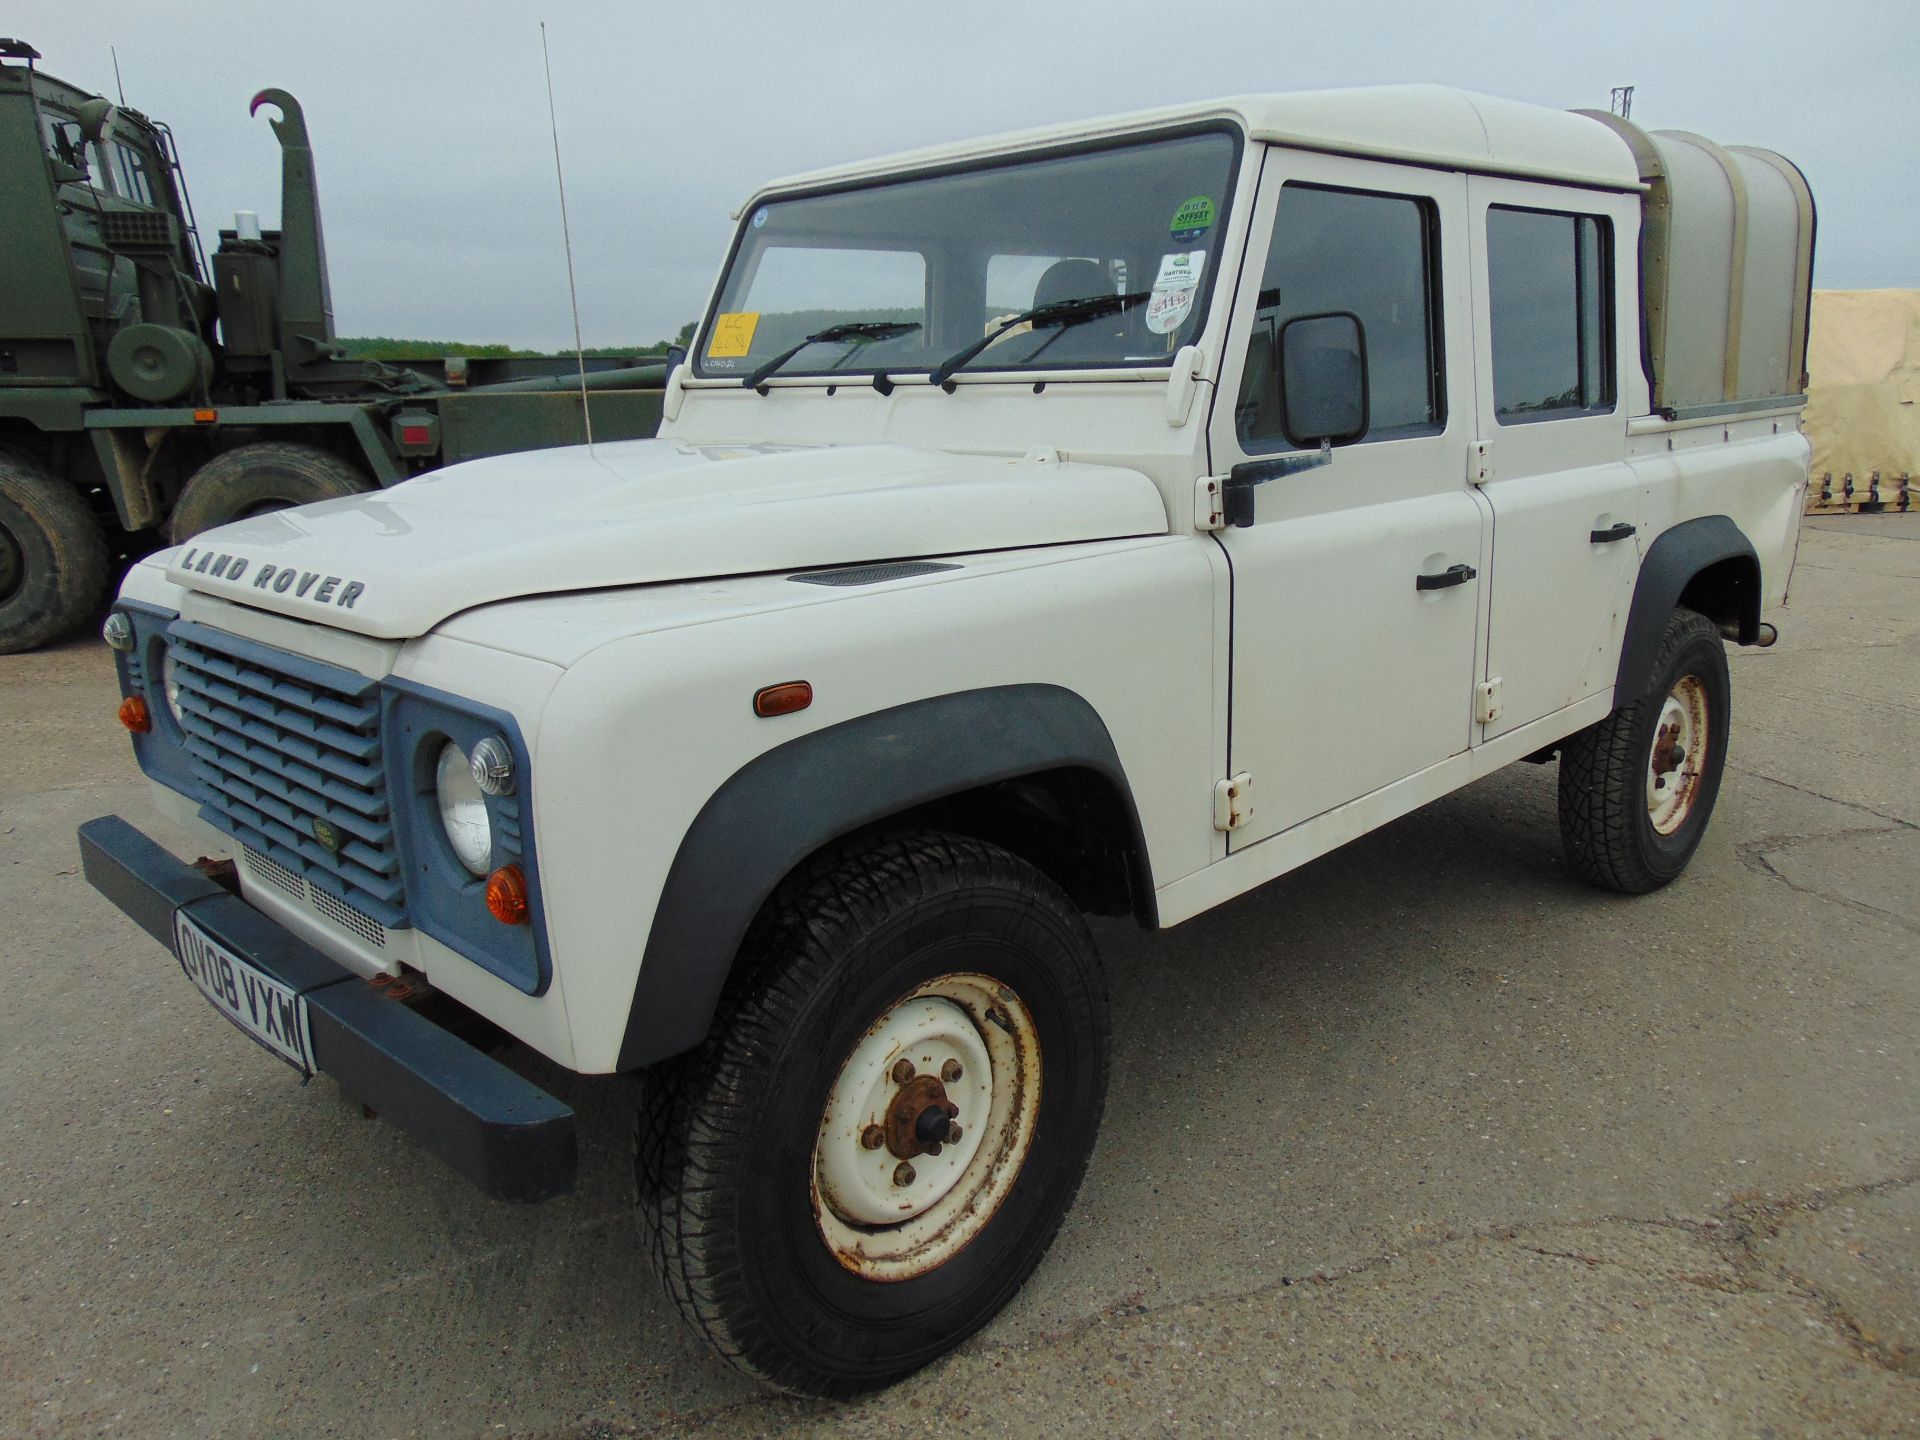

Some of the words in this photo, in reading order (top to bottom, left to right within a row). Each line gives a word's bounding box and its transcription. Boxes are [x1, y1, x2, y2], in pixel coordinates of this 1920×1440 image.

[1177, 209, 1210, 222] OFFSET
[724, 314, 746, 329] LC
[181, 548, 249, 581] LAND
[253, 564, 365, 609] ROVER
[181, 923, 240, 1012] OV08
[240, 969, 299, 1054] VXW
